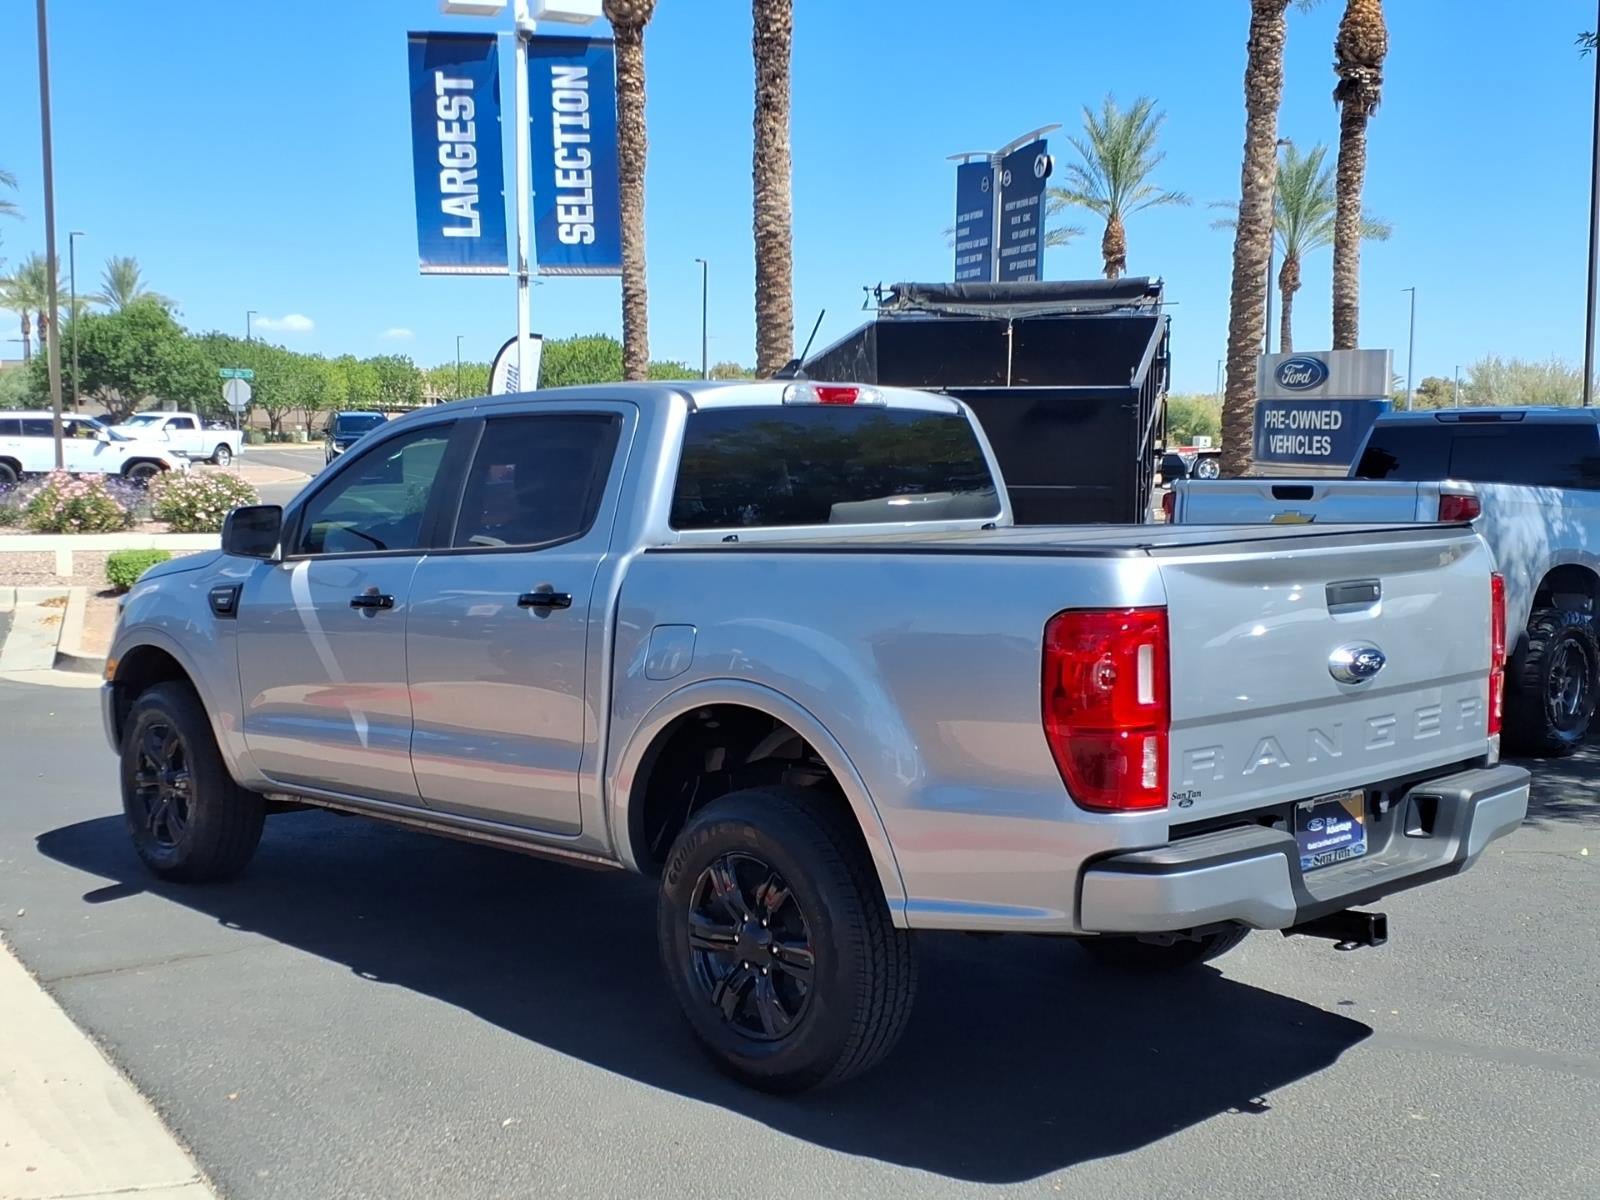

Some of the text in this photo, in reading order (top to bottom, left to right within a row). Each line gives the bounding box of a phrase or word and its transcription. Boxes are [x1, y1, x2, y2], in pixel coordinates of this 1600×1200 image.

[435, 71, 481, 237] LARGEST
[551, 65, 595, 245] SELECTION
[1281, 363, 1313, 385] Ford
[1264, 410, 1342, 430] PRE-OWNED
[1269, 435, 1332, 456] VEHICLES
[1182, 696, 1483, 785] RANGER
